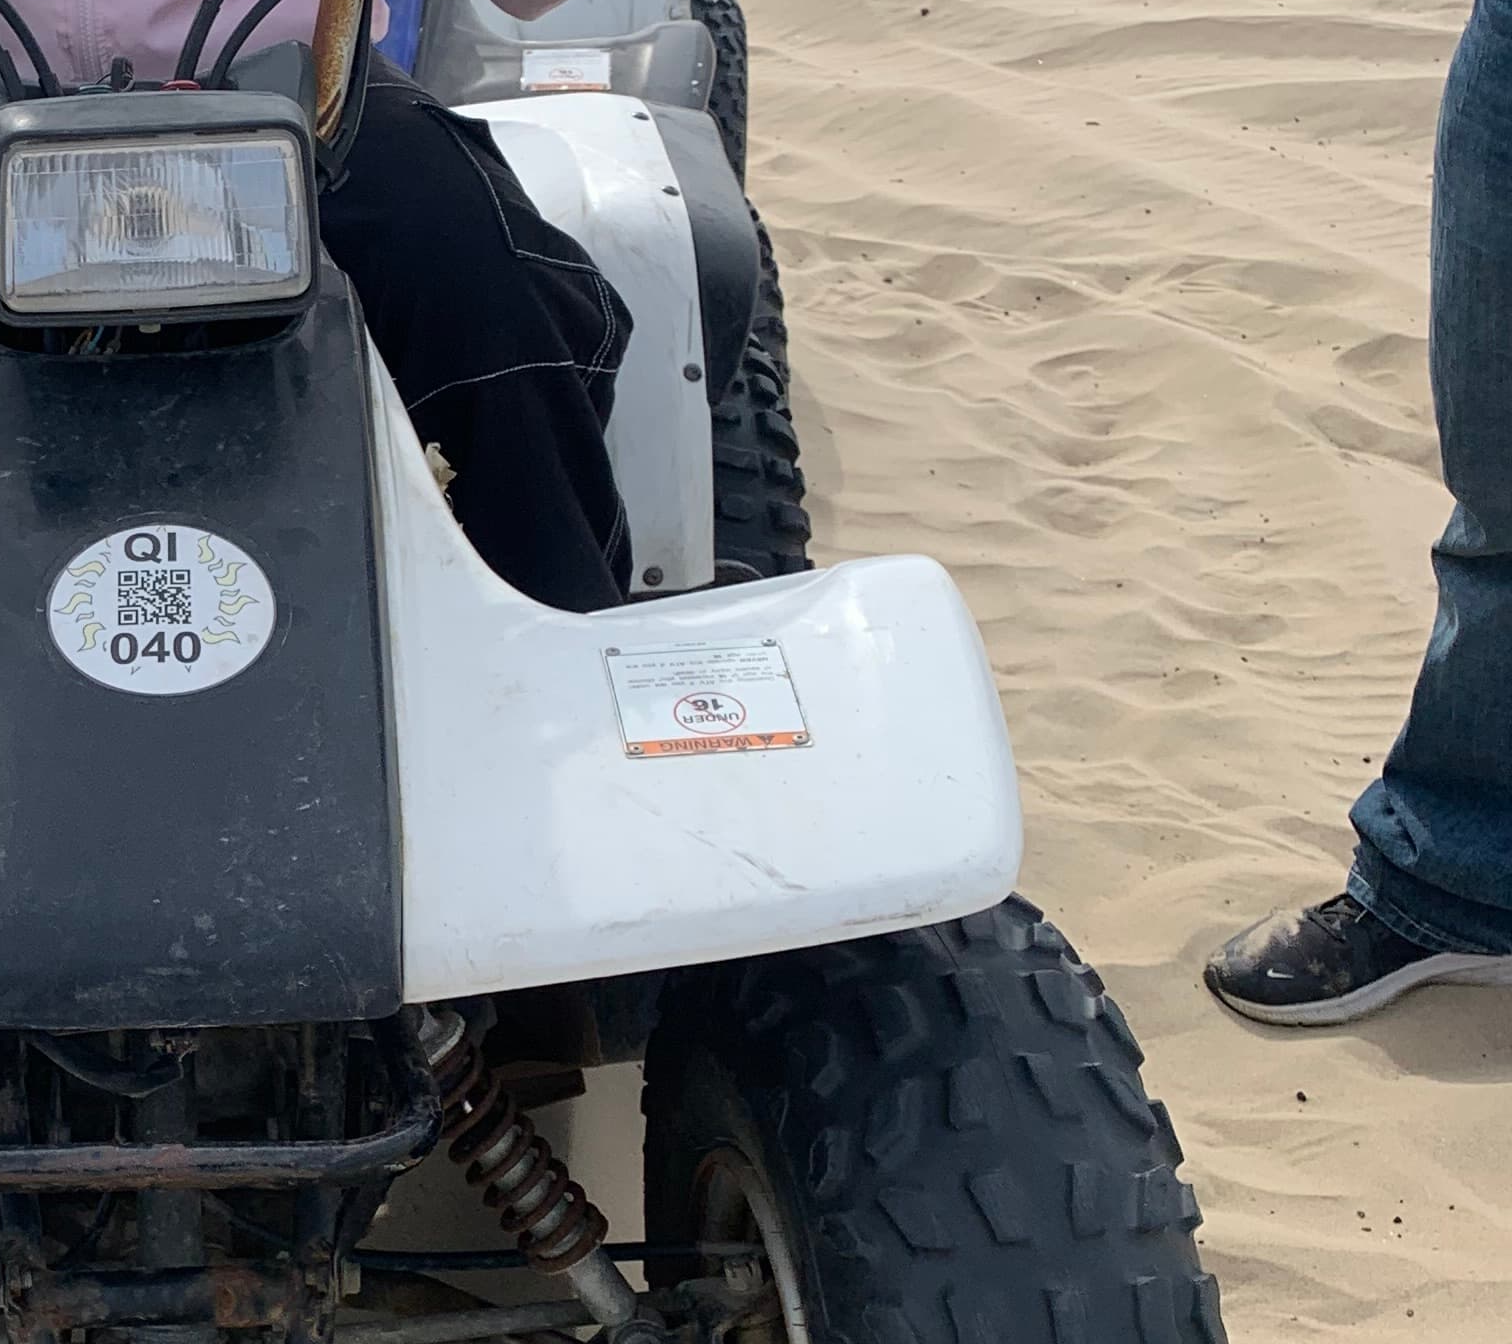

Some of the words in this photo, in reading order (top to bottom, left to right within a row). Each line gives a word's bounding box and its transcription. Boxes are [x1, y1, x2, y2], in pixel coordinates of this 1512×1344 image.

[124, 531, 177, 564] QI
[110, 630, 202, 665] 040
[691, 698, 725, 712] 16
[683, 712, 740, 724] UNDER
[660, 736, 753, 752] WARNING
